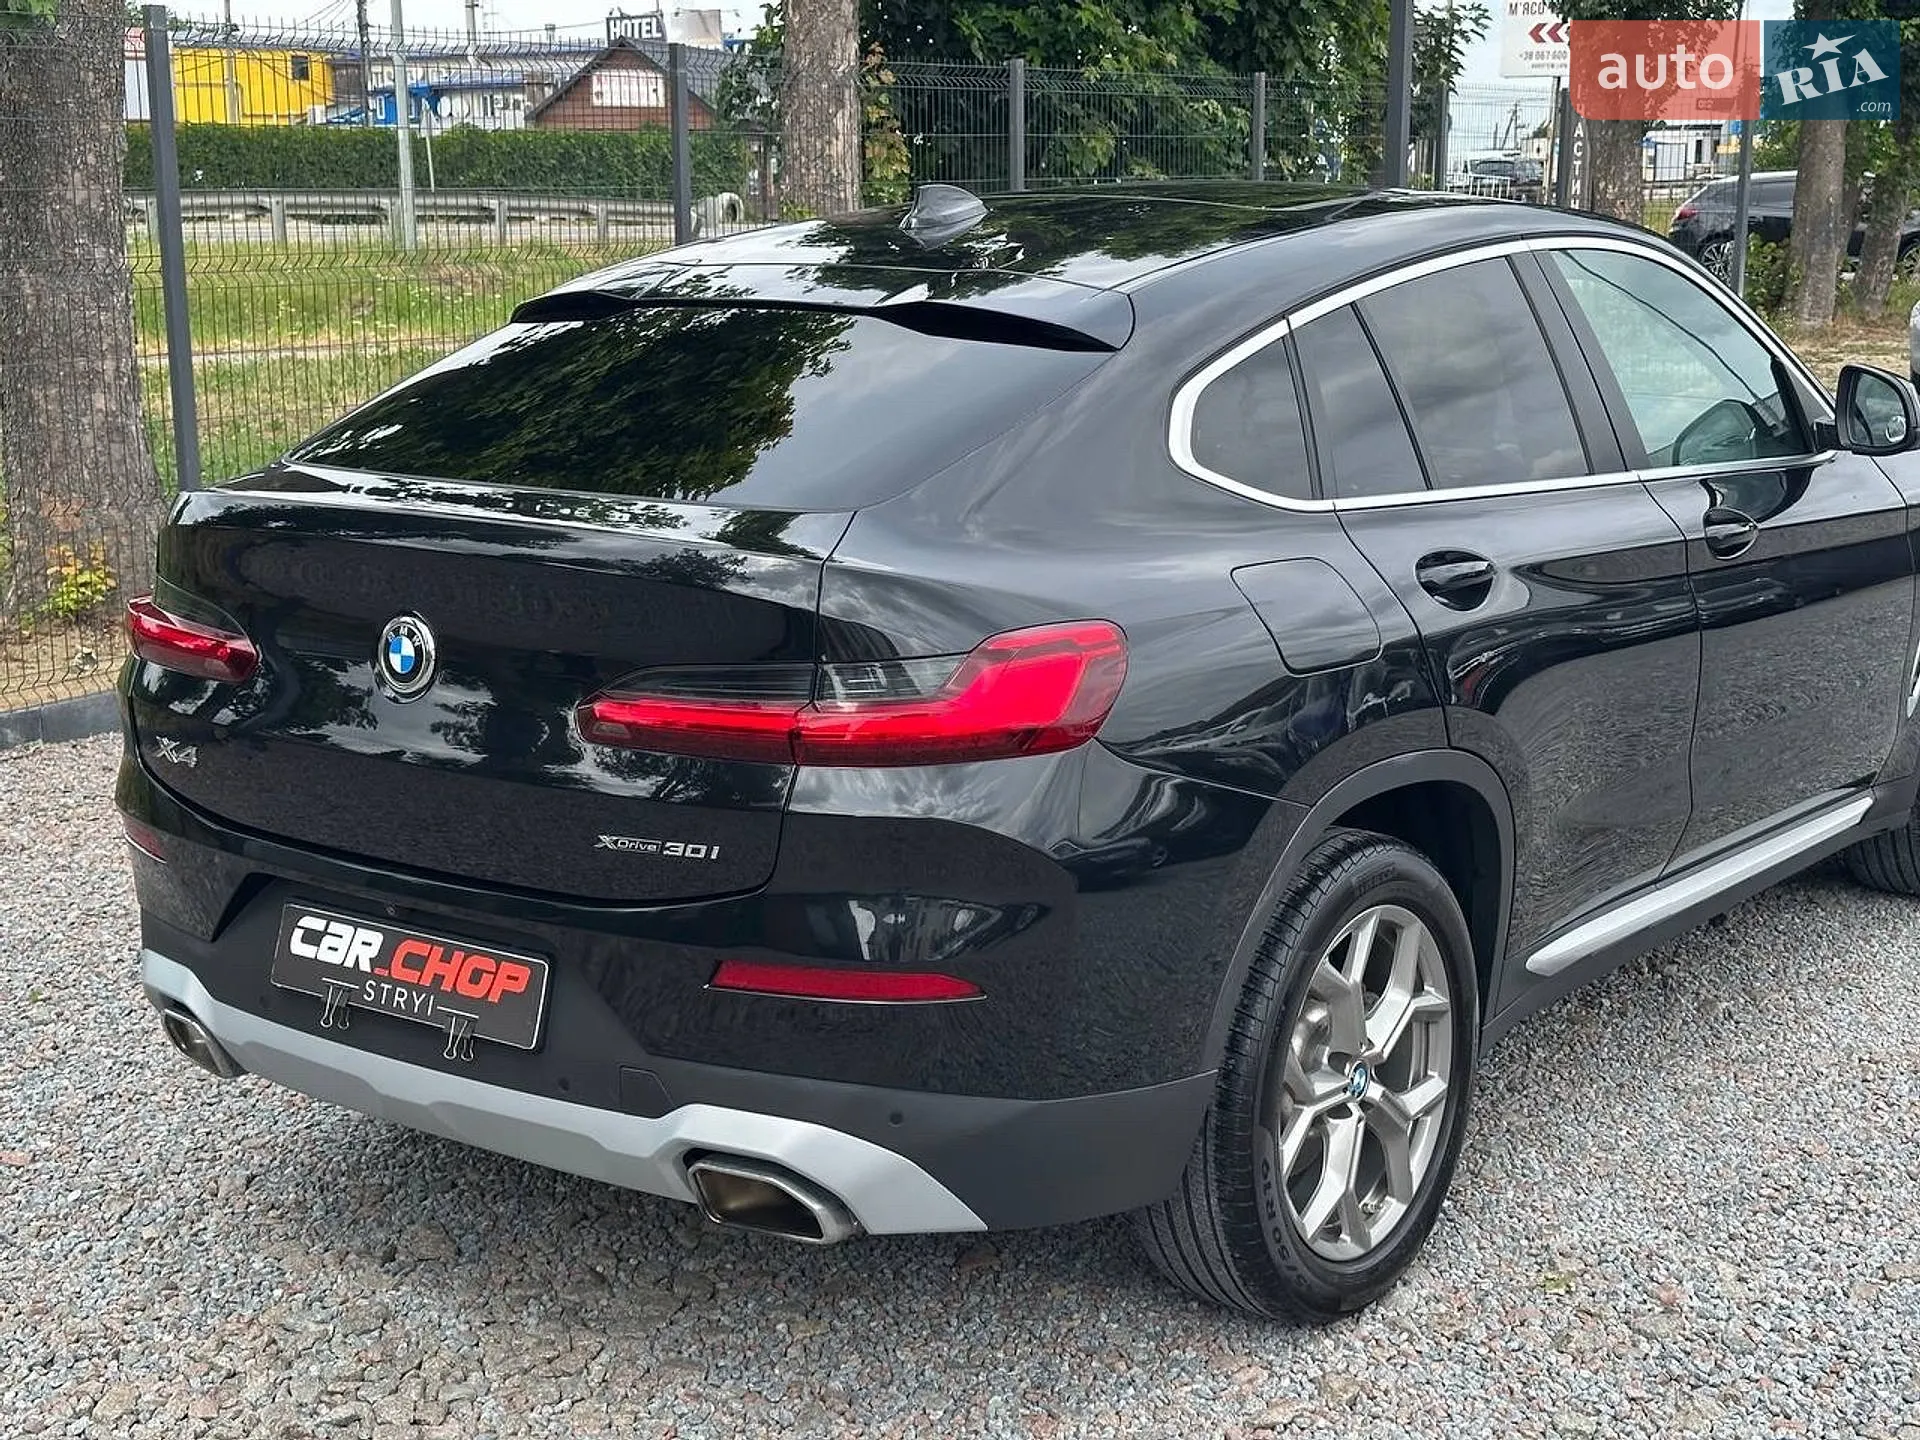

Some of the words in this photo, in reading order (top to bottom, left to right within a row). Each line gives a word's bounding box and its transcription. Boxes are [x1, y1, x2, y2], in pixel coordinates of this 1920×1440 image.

[609, 16, 663, 40] HOTEL
[155, 735, 198, 768] X4
[362, 979, 435, 1017] STRYI
